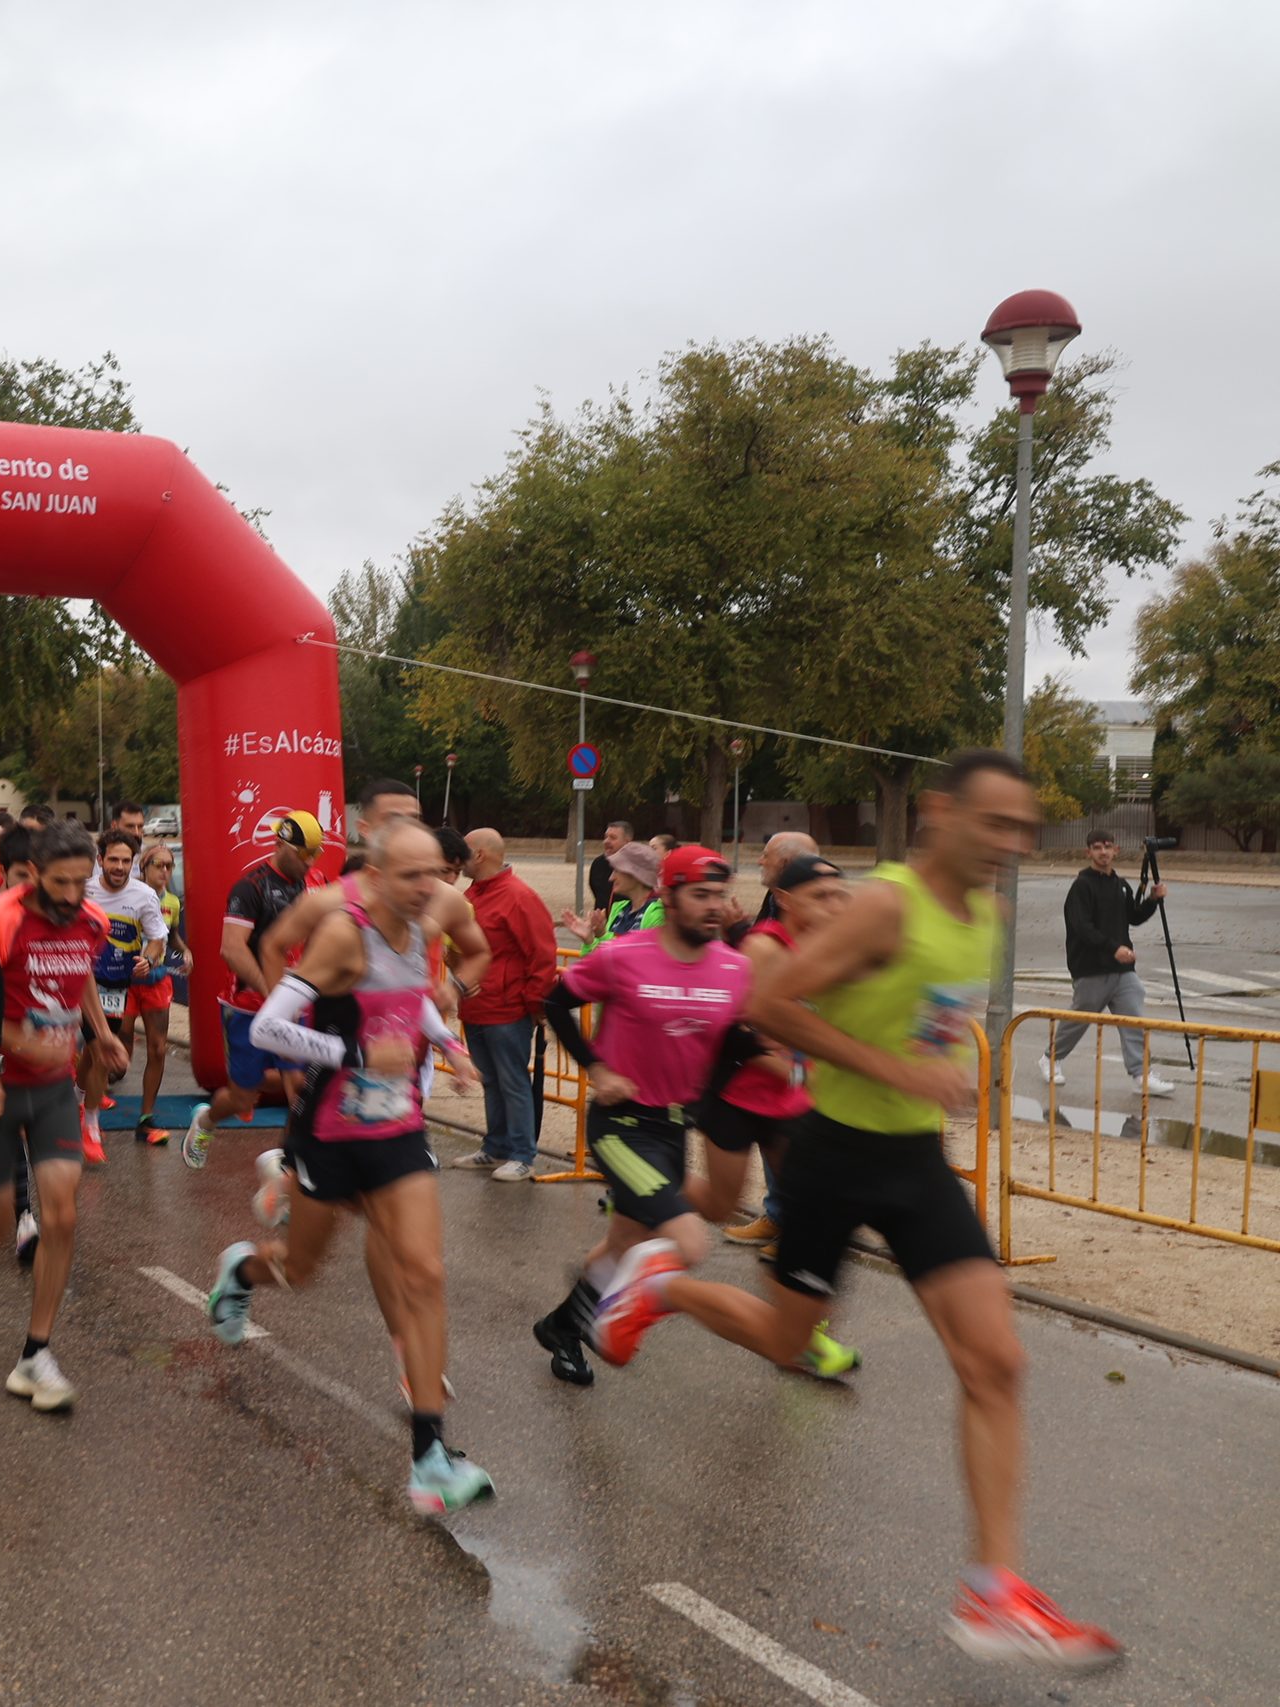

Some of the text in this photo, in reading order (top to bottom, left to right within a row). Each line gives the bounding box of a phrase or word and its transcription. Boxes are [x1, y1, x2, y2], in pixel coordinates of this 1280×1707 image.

[58, 458, 89, 481] de
[0, 490, 41, 512] SAN
[45, 493, 97, 515] JUAN
